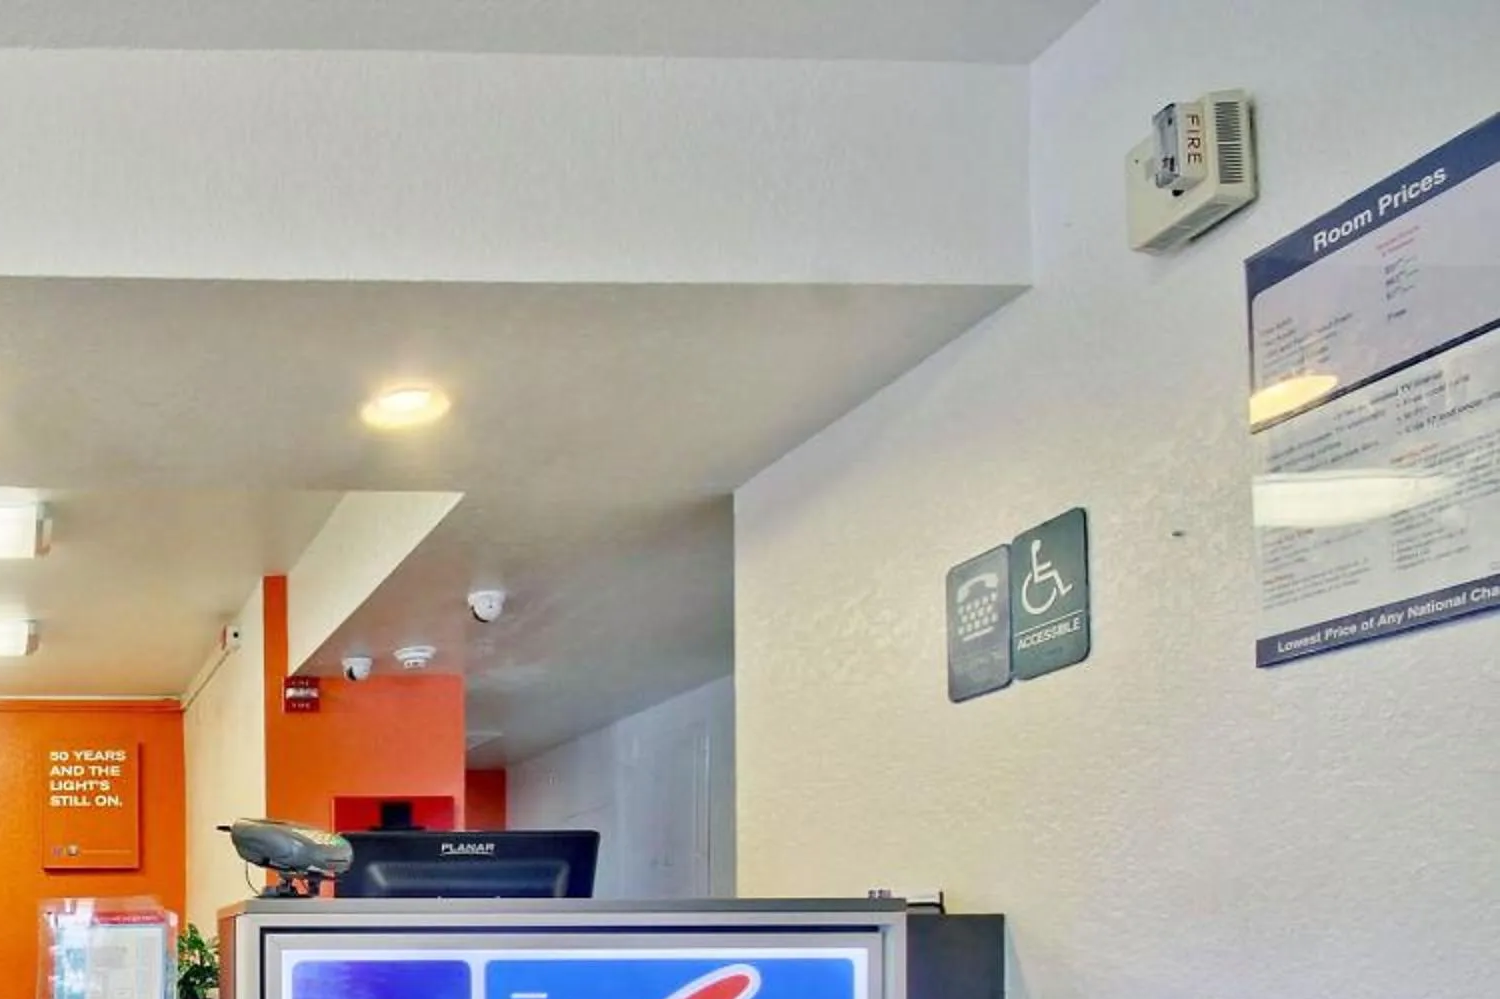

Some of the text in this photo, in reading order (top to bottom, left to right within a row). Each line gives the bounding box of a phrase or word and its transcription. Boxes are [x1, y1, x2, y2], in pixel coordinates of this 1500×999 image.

[1186, 114, 1202, 164] FIRE
[1312, 208, 1373, 254] Room
[1377, 166, 1449, 217] Prices
[1017, 617, 1081, 650] ACCESSIBLE
[1277, 634, 1322, 653] Lowest
[1325, 623, 1358, 641] Price
[1360, 618, 1374, 633] of
[1376, 610, 1405, 628] Any
[1407, 592, 1467, 618] National
[50, 750, 127, 762] 50 YEARS
[50, 765, 121, 777] AND THE
[50, 795, 124, 808] STILL ON.
[441, 843, 495, 855] PLANAR
